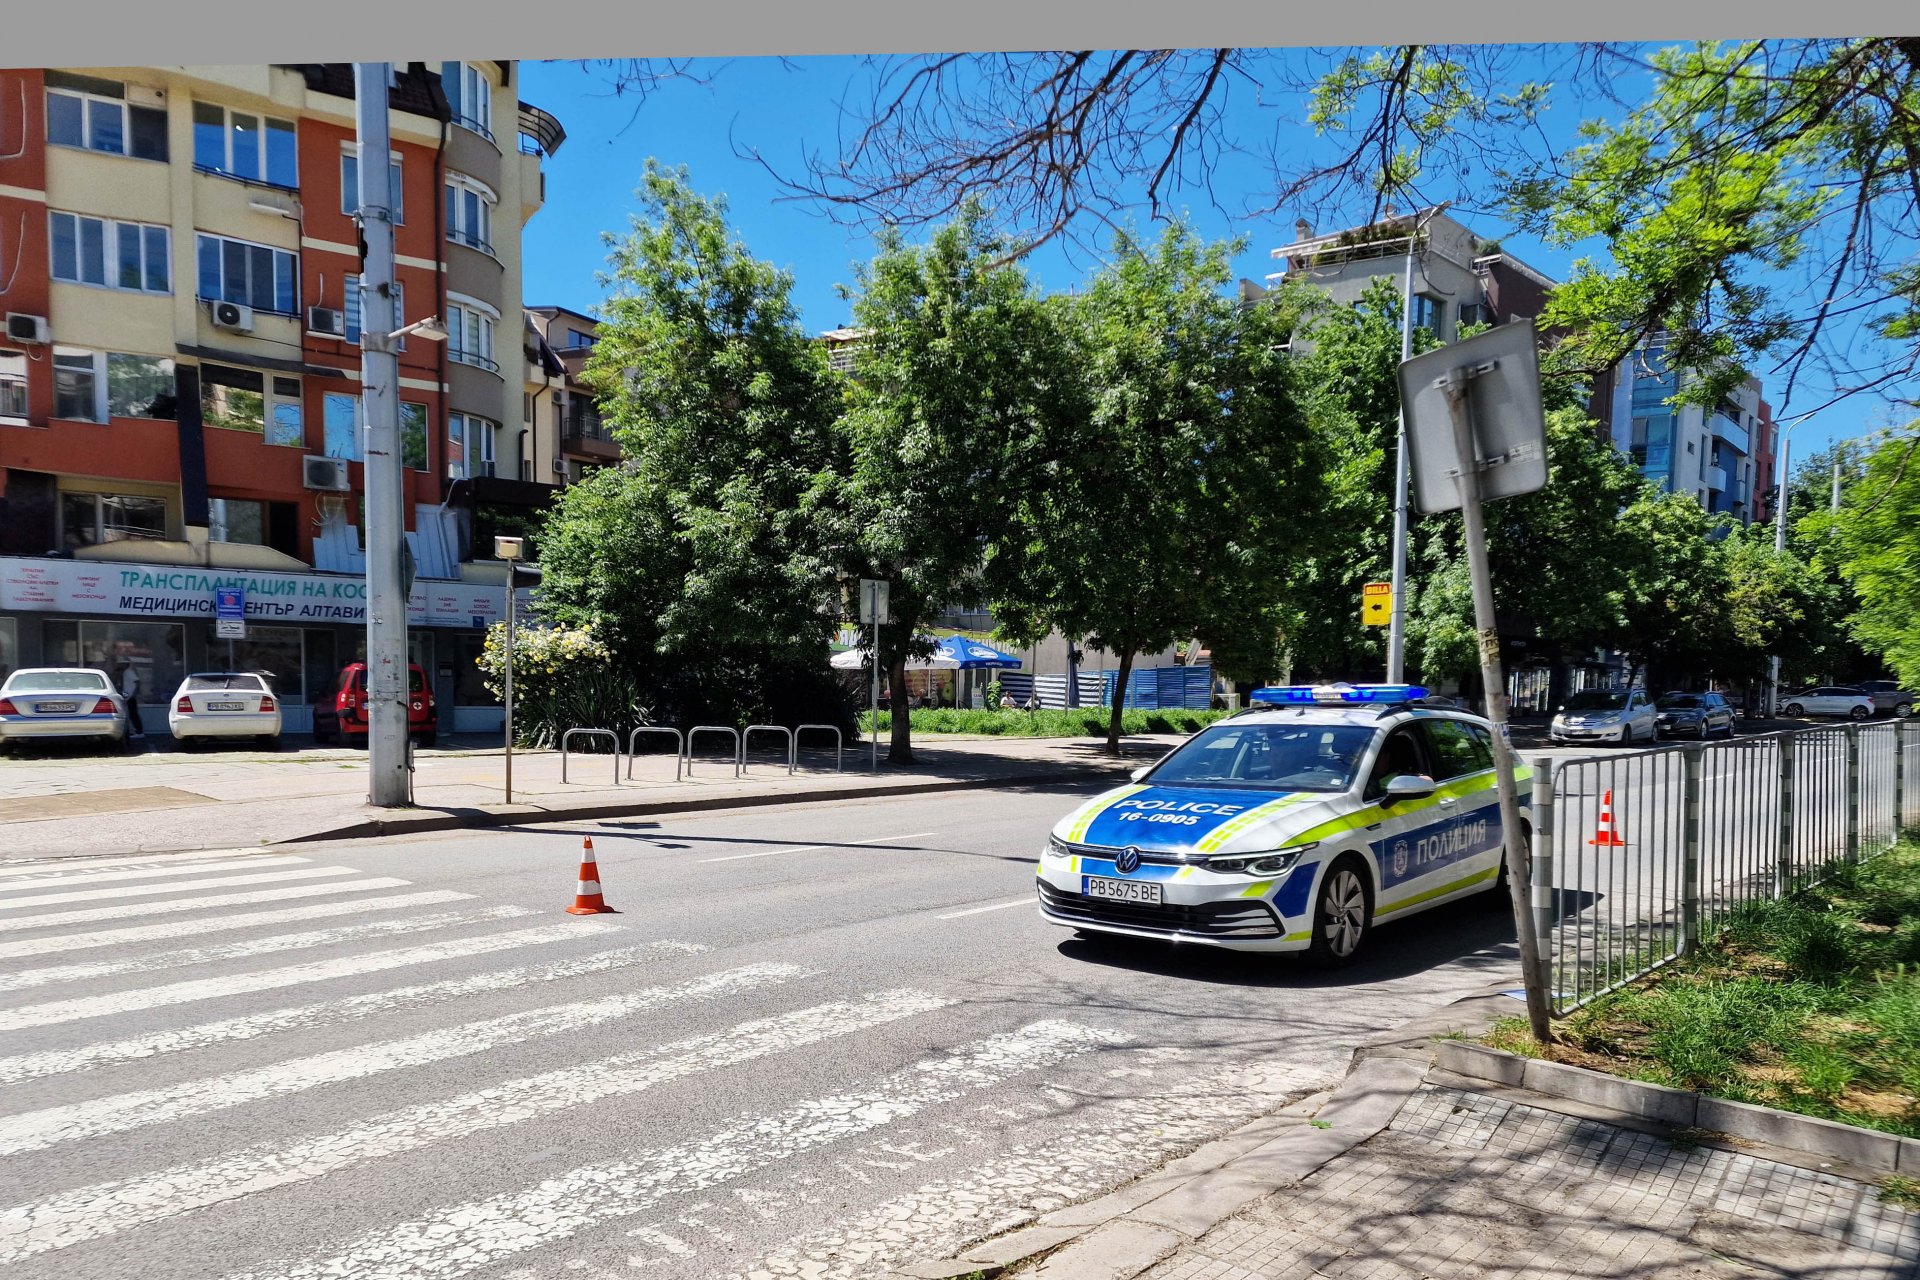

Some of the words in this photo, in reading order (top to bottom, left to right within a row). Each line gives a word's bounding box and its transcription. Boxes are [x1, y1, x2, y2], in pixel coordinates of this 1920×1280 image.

[303, 581, 327, 598] НА
[333, 583, 367, 600] КОС
[1365, 585, 1389, 595] BILLA
[120, 596, 217, 614] МЕДИЦИНСК
[244, 601, 295, 616] ЕНТЪР
[300, 604, 367, 619] АЛТАВИ
[1114, 799, 1244, 816] POLICE
[1119, 811, 1201, 826] 16-0905
[1416, 819, 1486, 866] ПОЛИЦИЯ
